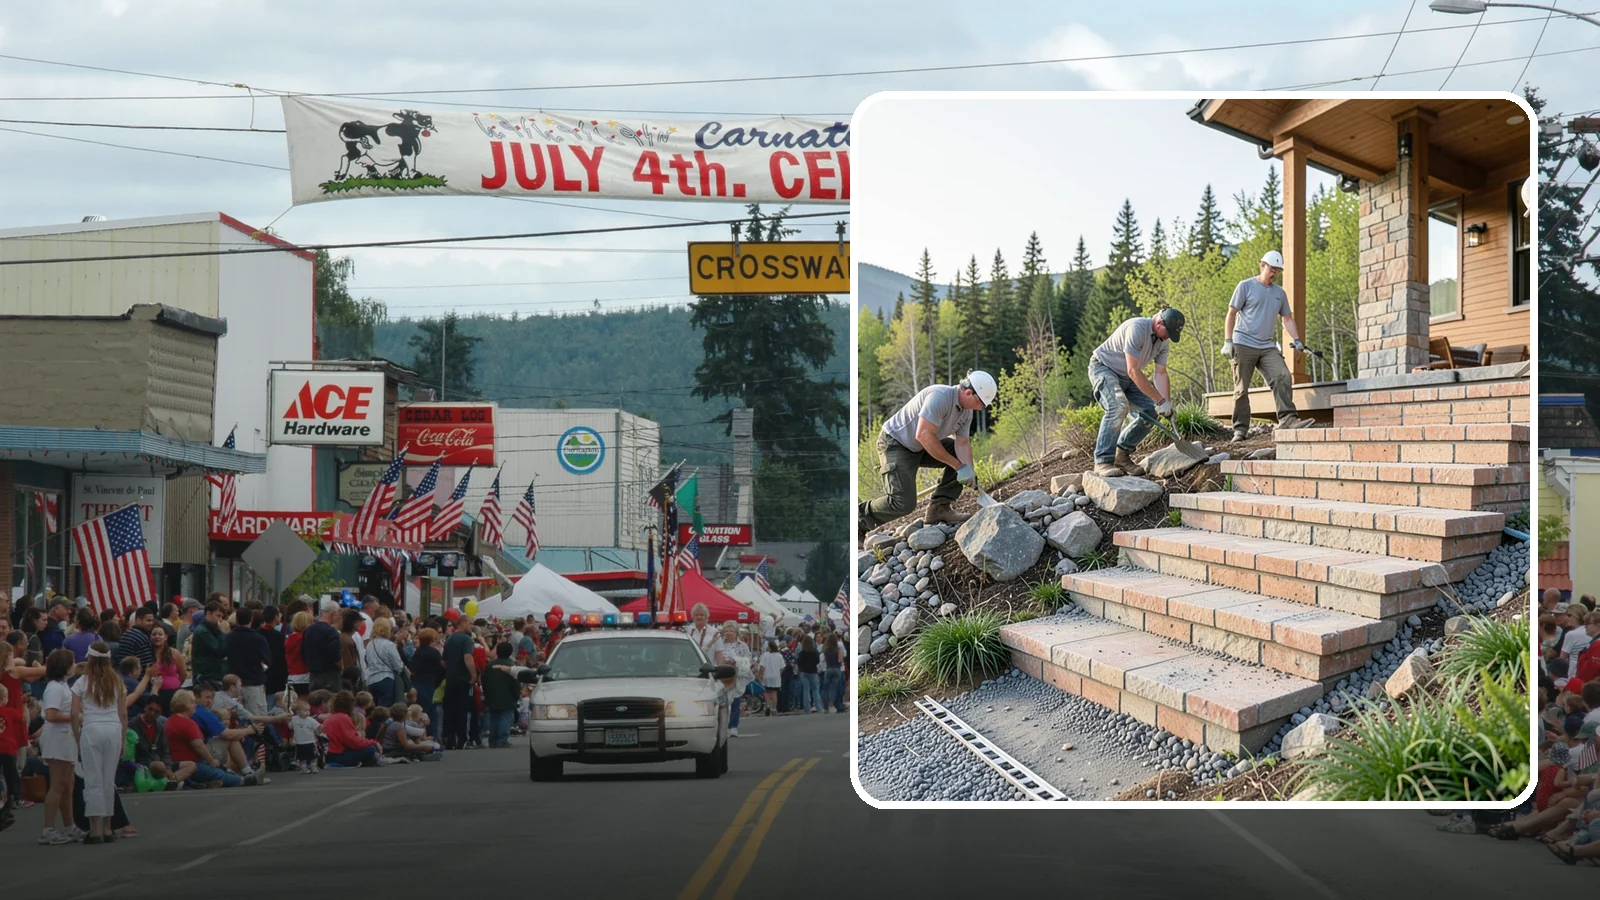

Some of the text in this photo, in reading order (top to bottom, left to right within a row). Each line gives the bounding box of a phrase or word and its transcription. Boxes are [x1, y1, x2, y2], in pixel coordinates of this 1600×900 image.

[694, 121, 850, 149] Carnat
[481, 141, 605, 192] JULY
[632, 150, 747, 197] 4th.
[697, 254, 850, 280] CROSSWA
[283, 380, 374, 420] ACE
[406, 409, 485, 421] CEDAR LOG
[283, 421, 371, 436] Hardware
[83, 485, 155, 495] St. Vincent de Paul
[698, 535, 730, 543] GLASS
